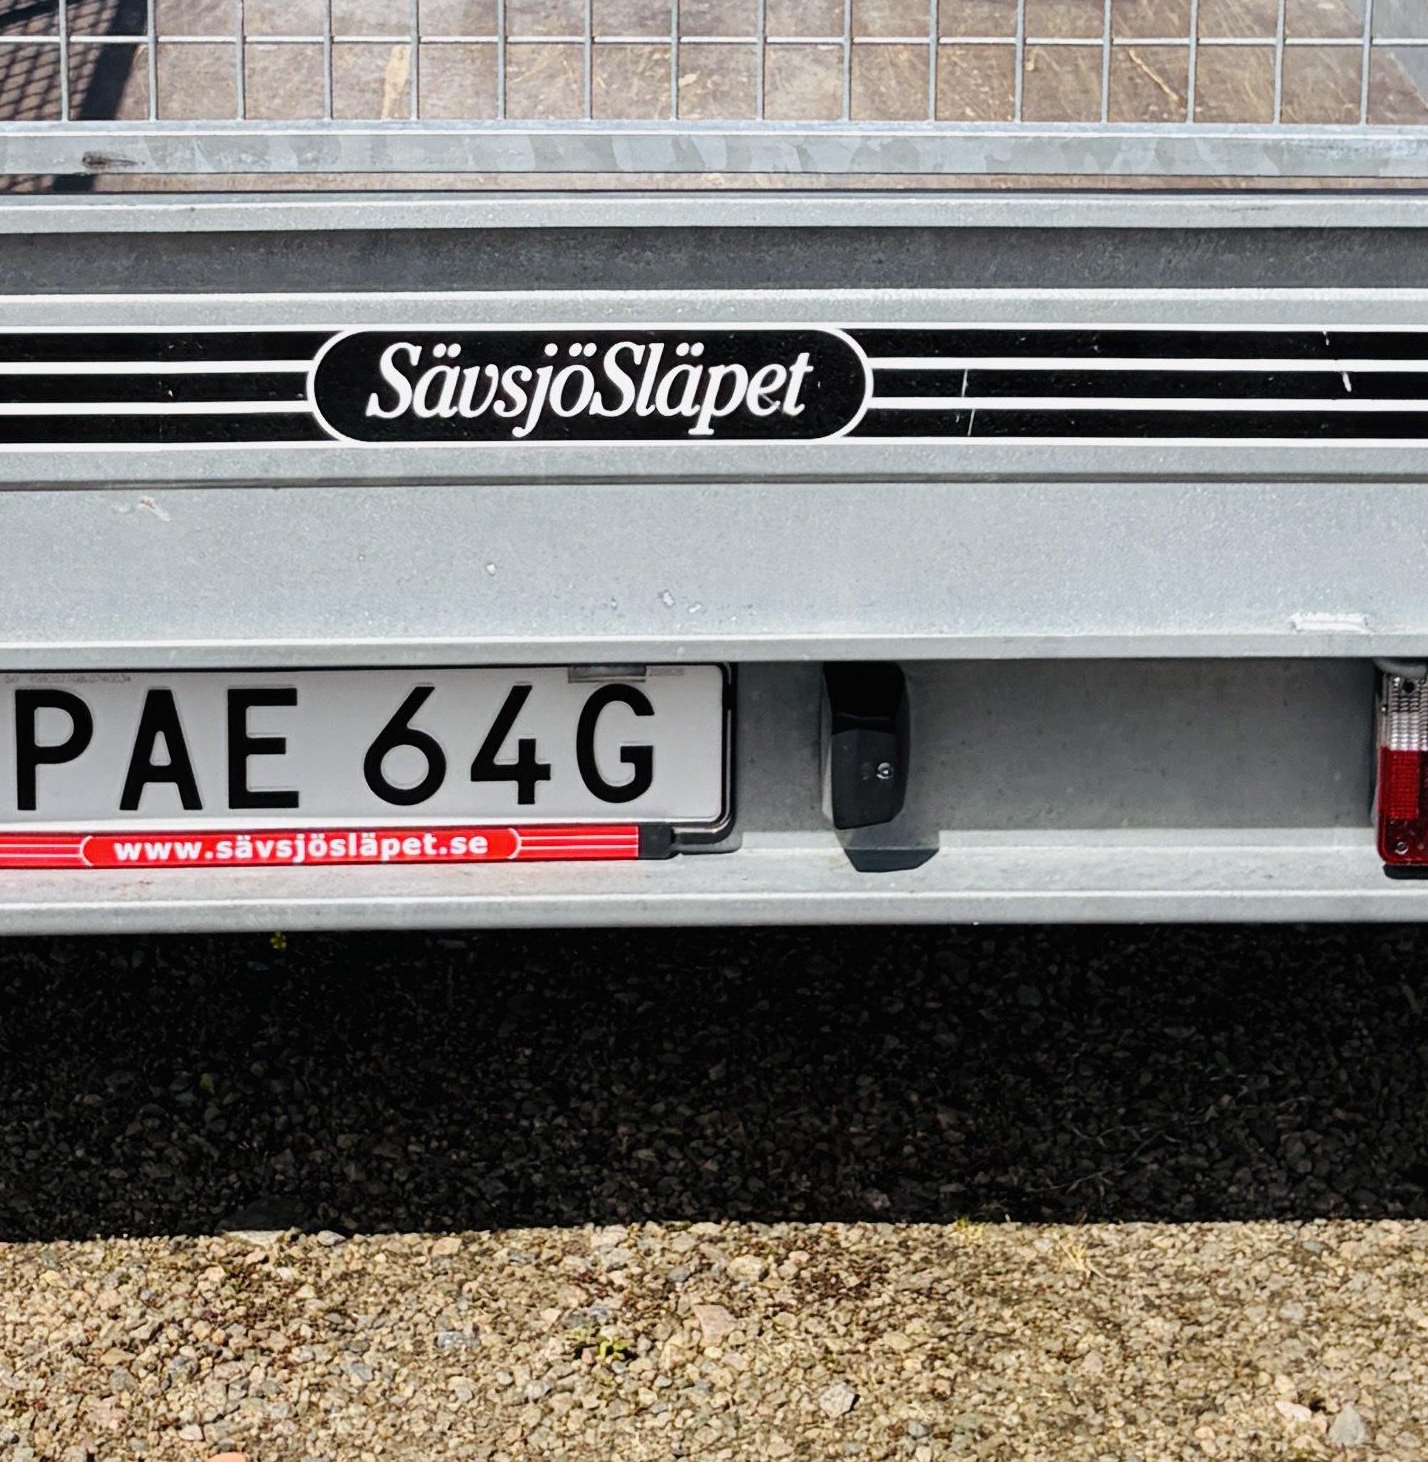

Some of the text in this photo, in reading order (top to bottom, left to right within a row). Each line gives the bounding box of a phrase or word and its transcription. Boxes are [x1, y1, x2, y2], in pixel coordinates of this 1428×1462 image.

[365, 341, 814, 438] SävsjöSläpet
[13, 682, 656, 812] PAE 64G
[113, 832, 489, 864] www.sävsjösläpet.se
